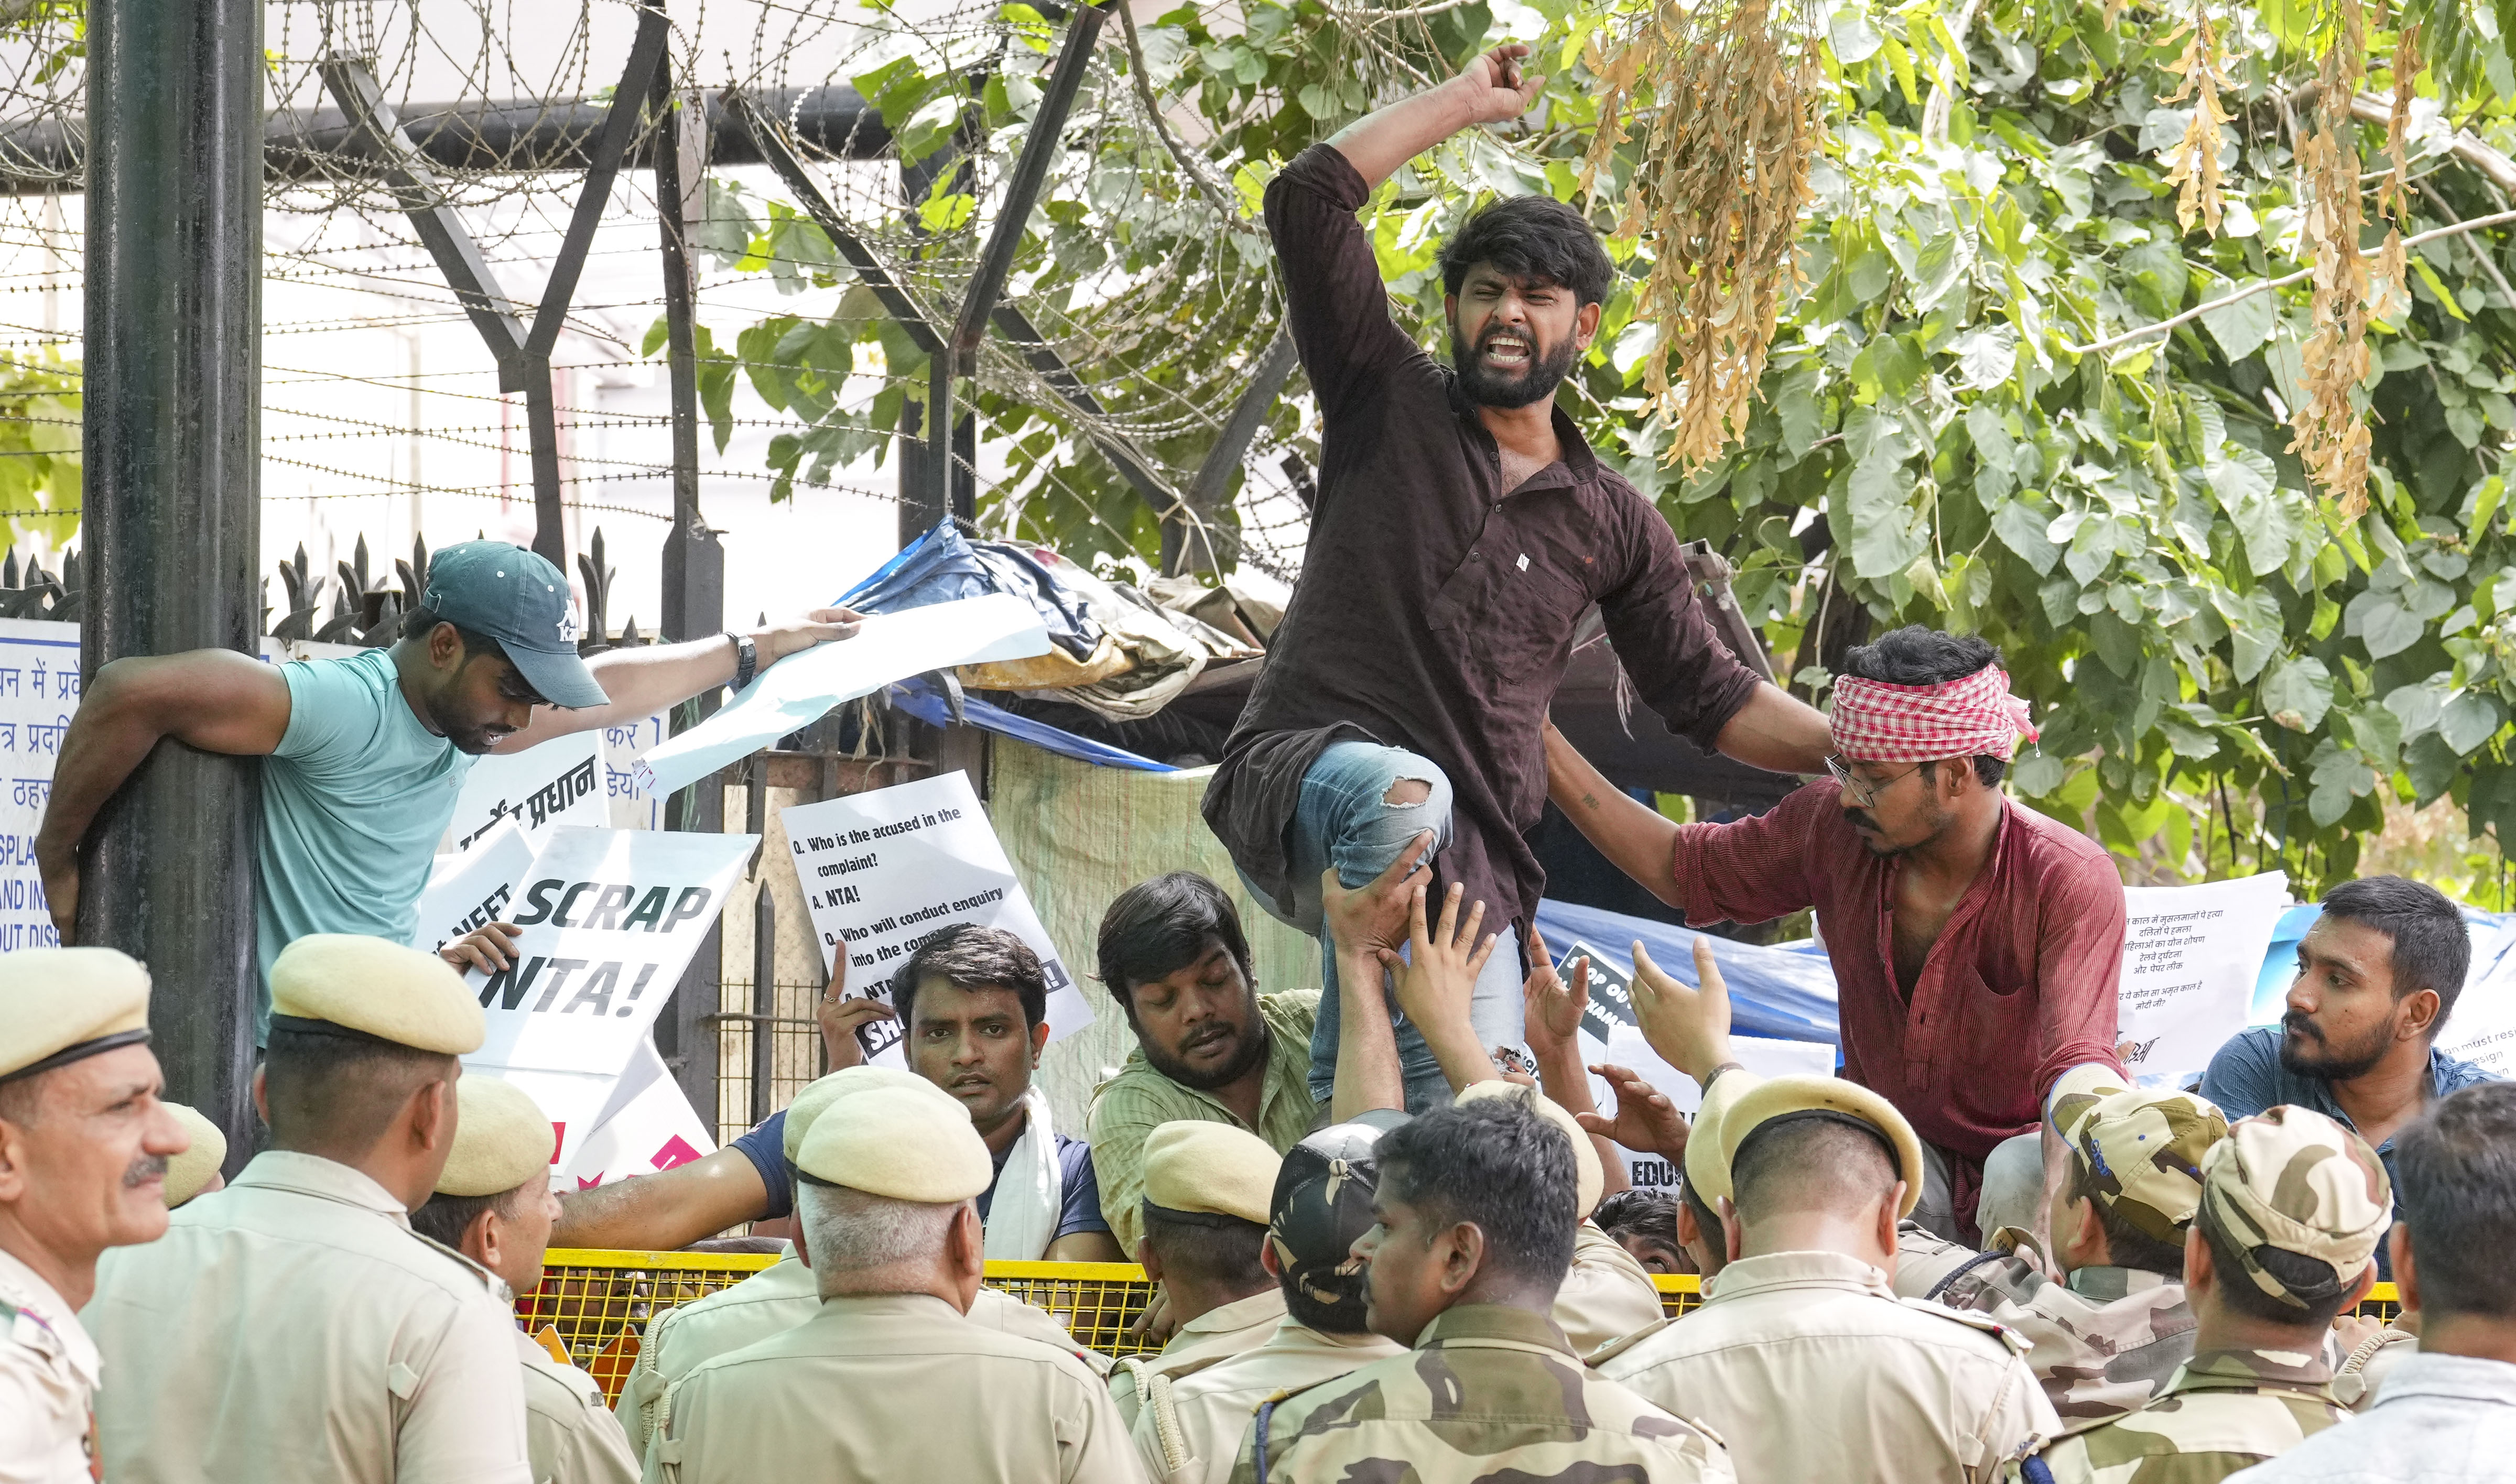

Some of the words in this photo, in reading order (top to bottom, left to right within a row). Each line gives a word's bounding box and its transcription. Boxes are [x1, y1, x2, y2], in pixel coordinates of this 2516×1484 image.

[31, 657, 46, 699] में
[526, 754, 597, 831] प्रधान
[793, 840, 805, 855] Q.
[807, 835, 834, 852] Who
[835, 833, 847, 847] is
[849, 830, 871, 845] the
[872, 816, 921, 839] accused
[923, 813, 937, 828] in
[938, 808, 961, 823] the
[817, 853, 879, 878] complaint?
[512, 879, 712, 933] SCRAP
[812, 896, 823, 910] A.
[825, 885, 861, 908] NTA!
[839, 928, 869, 943] Who
[870, 916, 897, 934] will
[899, 902, 951, 926] conduct
[952, 887, 1004, 912] enquiry
[850, 954, 874, 967] into
[877, 945, 902, 961] the
[1567, 956, 1607, 985] SOP
[479, 956, 659, 1018] NTA!
[2461, 1035, 2492, 1051] must
[2468, 1051, 2503, 1064] esign
